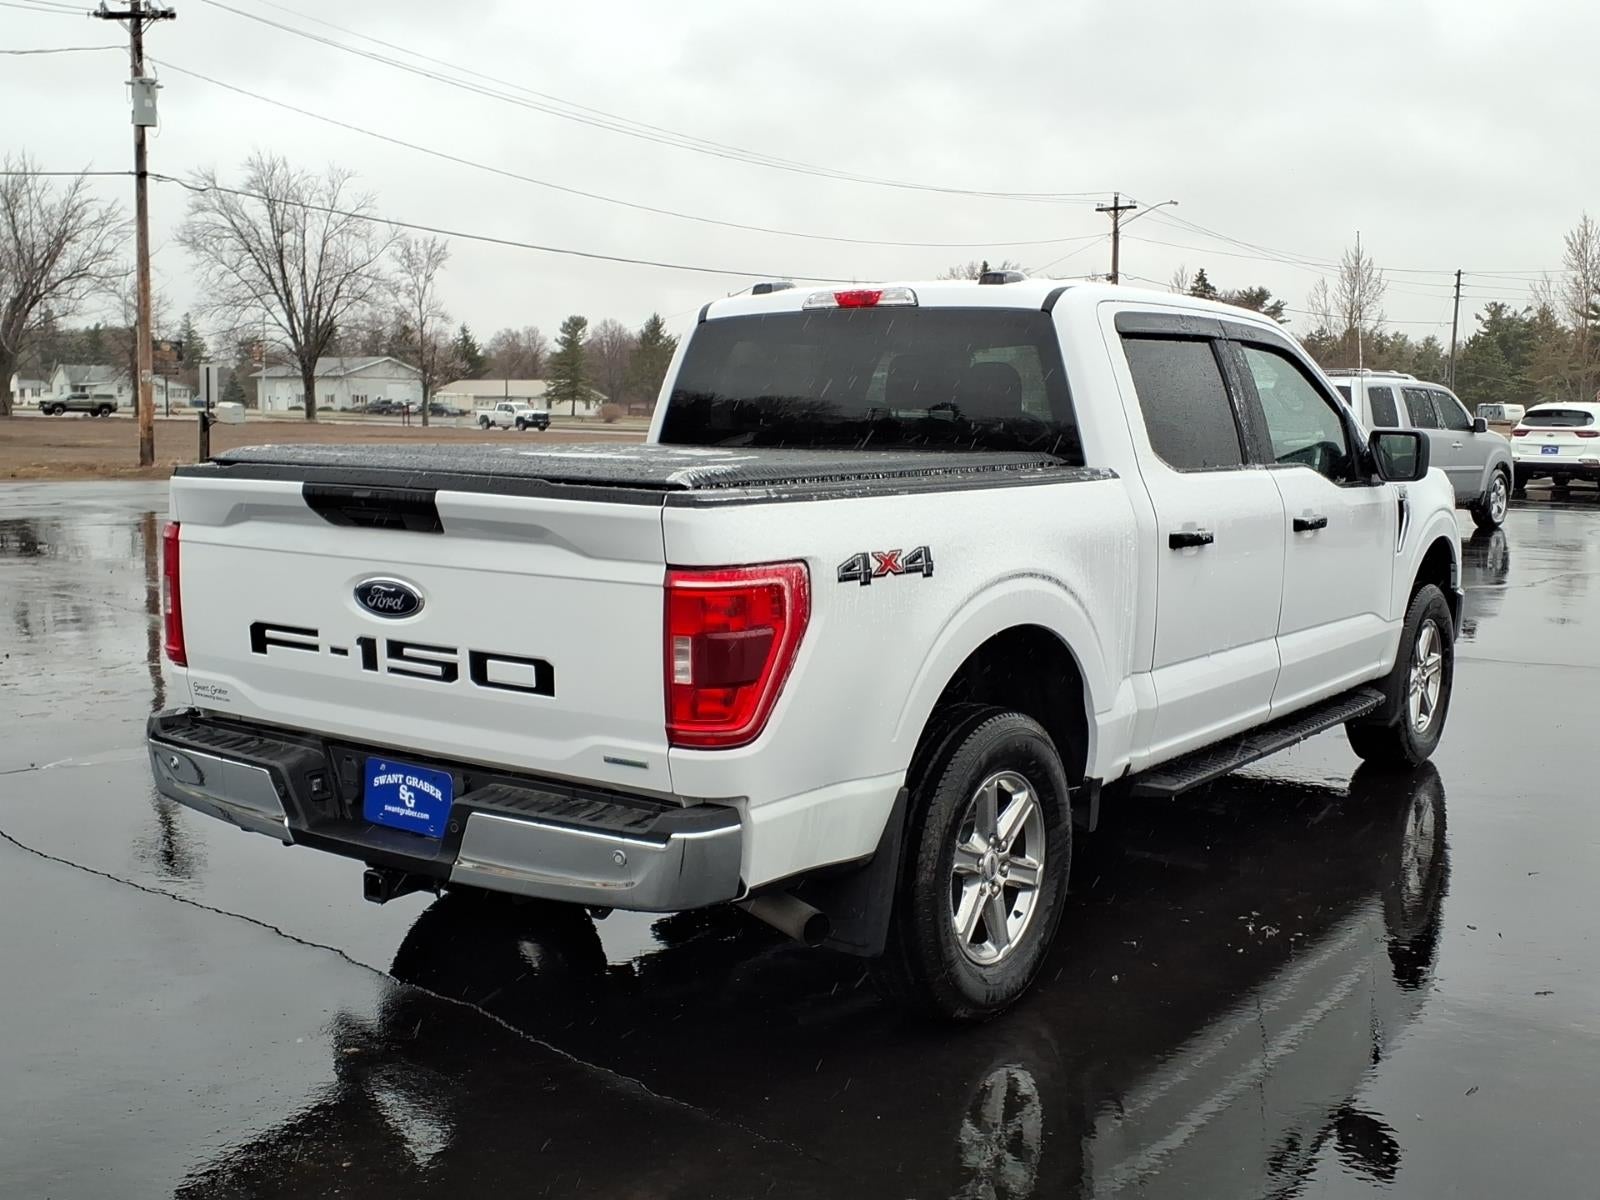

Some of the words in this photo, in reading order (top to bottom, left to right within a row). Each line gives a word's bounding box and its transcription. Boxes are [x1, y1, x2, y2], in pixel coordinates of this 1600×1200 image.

[366, 585, 405, 610] Ford
[249, 621, 556, 698] F-150
[373, 774, 404, 787] SWANT
[405, 775, 443, 802] GRABER
[384, 804, 430, 820] swantgraber.com
